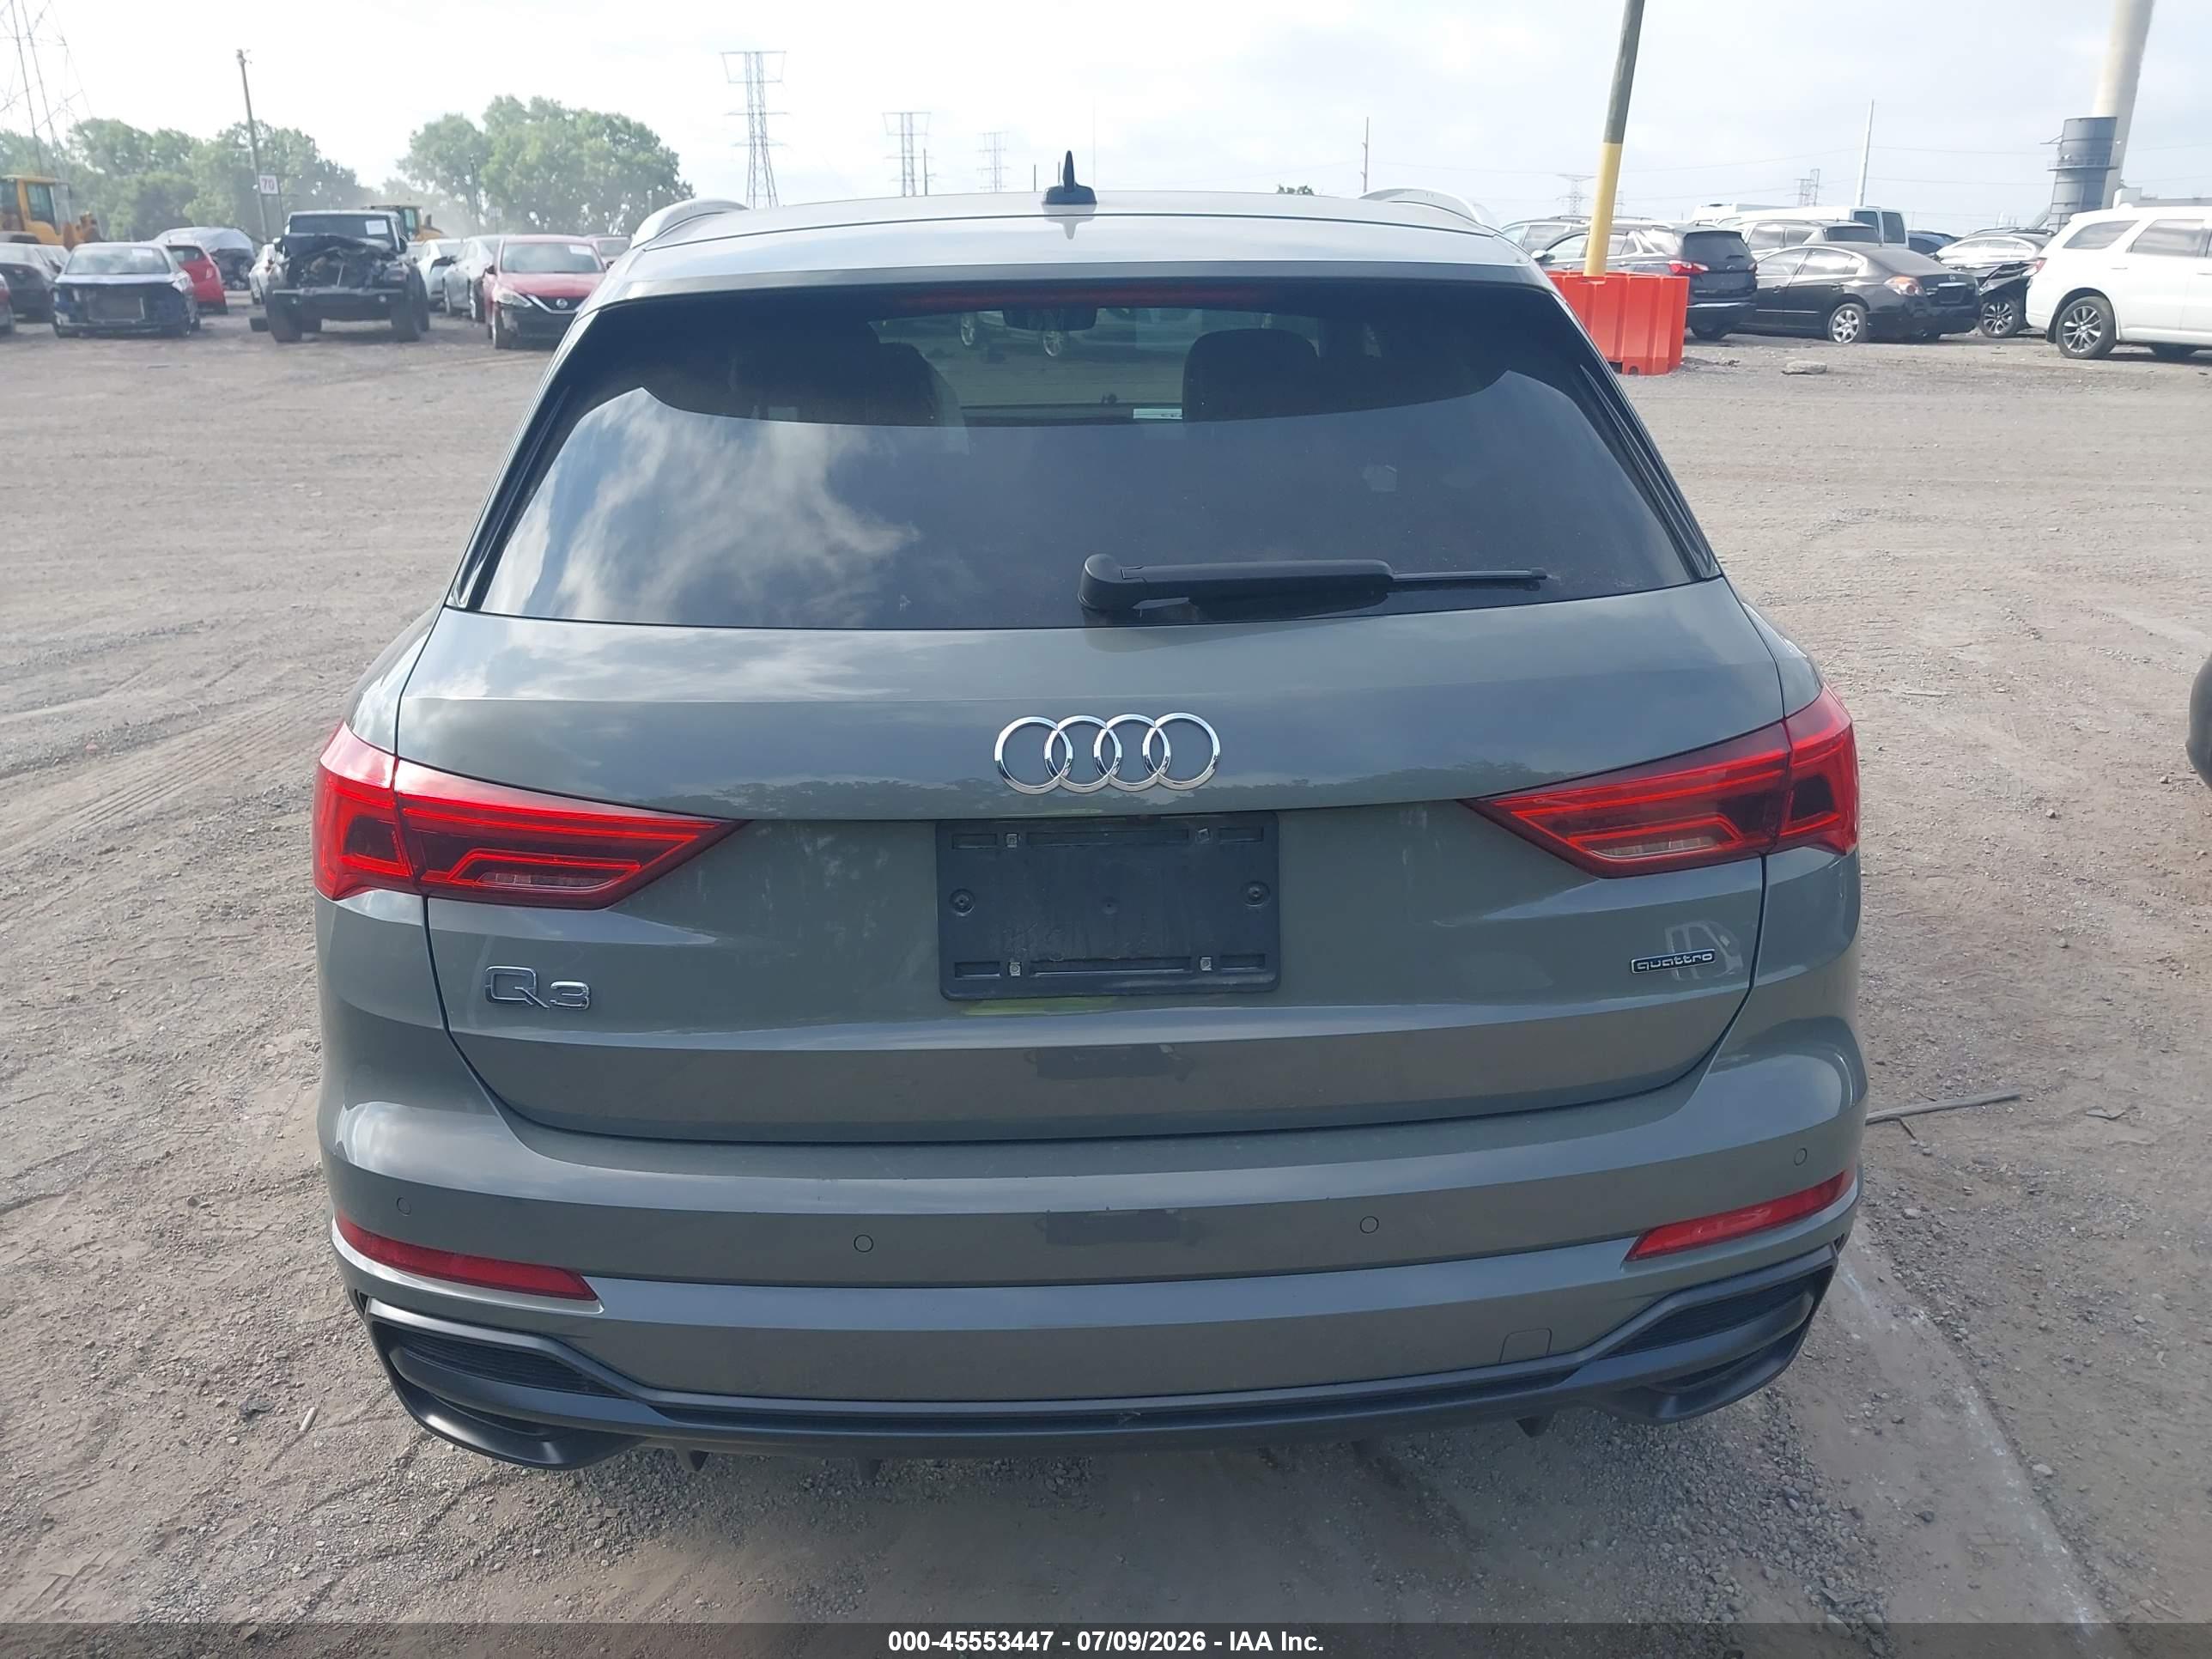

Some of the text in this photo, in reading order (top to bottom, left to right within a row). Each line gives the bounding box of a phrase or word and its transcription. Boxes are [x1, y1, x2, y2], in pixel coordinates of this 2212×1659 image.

[261, 178, 276, 191] 70
[1637, 953, 1713, 971] quattro
[484, 965, 591, 1011] Q3
